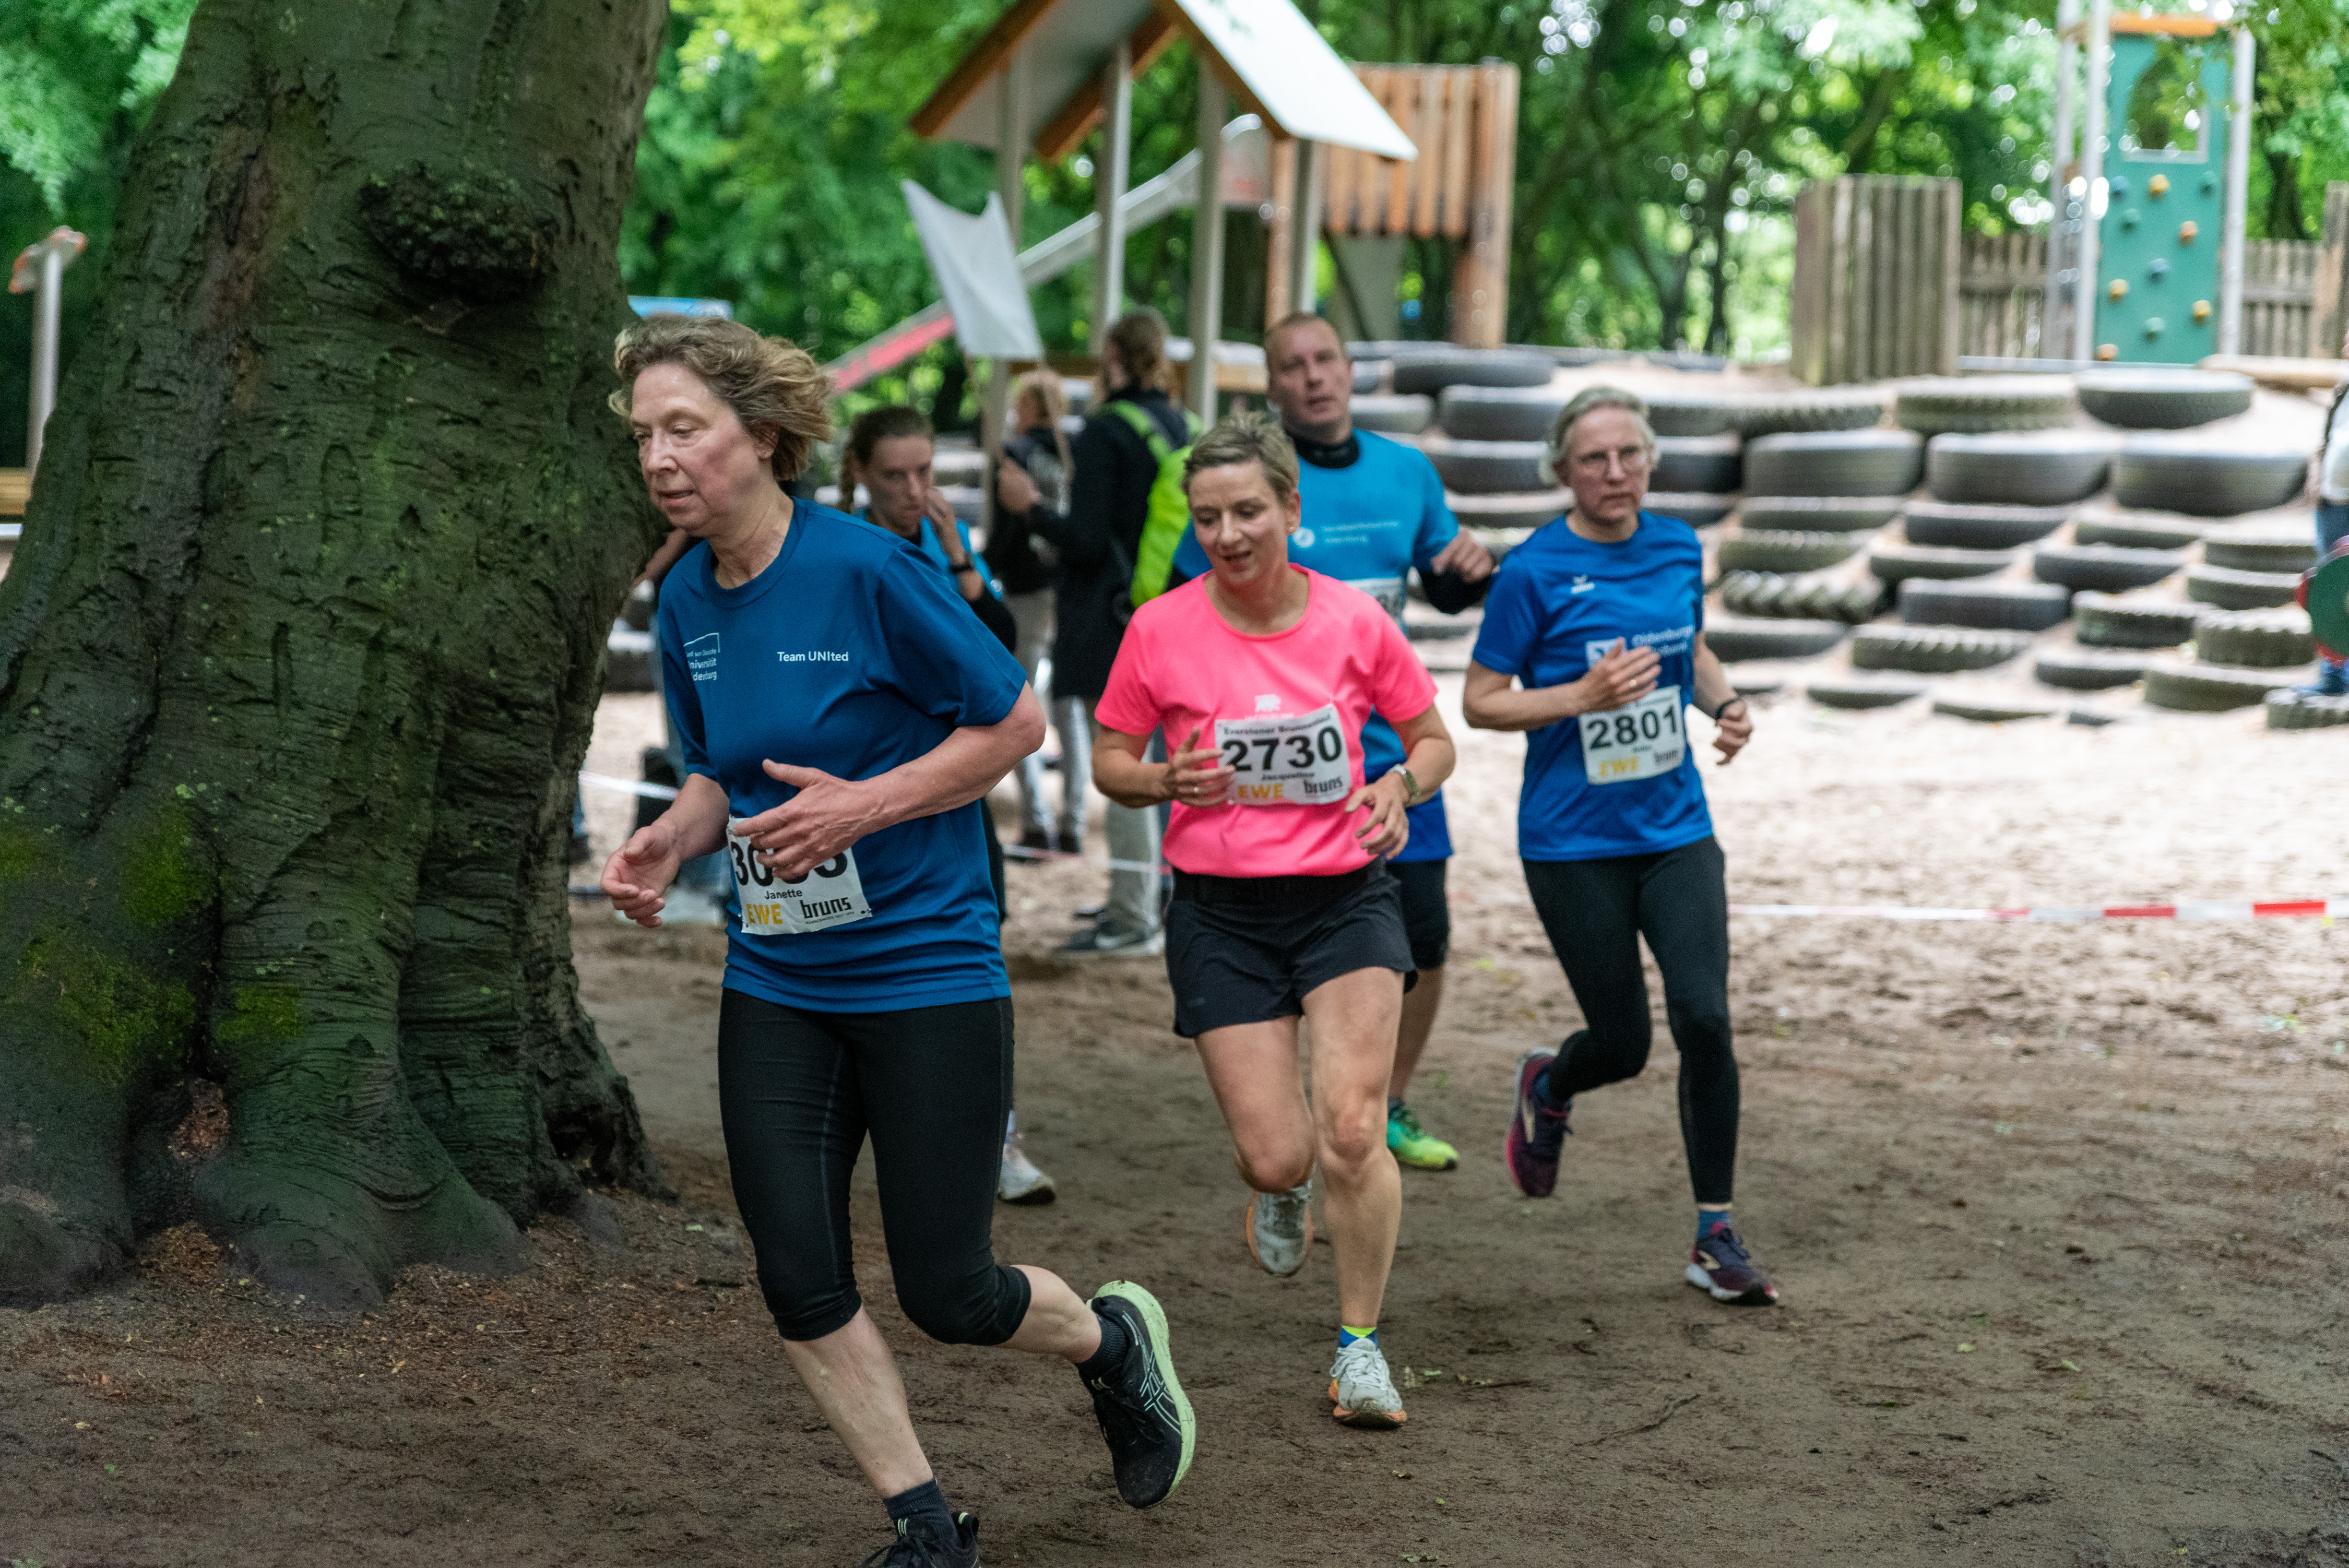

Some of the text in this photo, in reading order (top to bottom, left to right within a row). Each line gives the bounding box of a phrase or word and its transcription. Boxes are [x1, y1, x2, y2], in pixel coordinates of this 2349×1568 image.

[777, 651, 849, 661] Team UNIted
[1587, 705, 1677, 751] 2801
[1222, 726, 1342, 771] 2730
[1238, 776, 1343, 798] EWE bruns
[765, 889, 803, 899] Janette
[746, 897, 852, 925] EWE bruns
